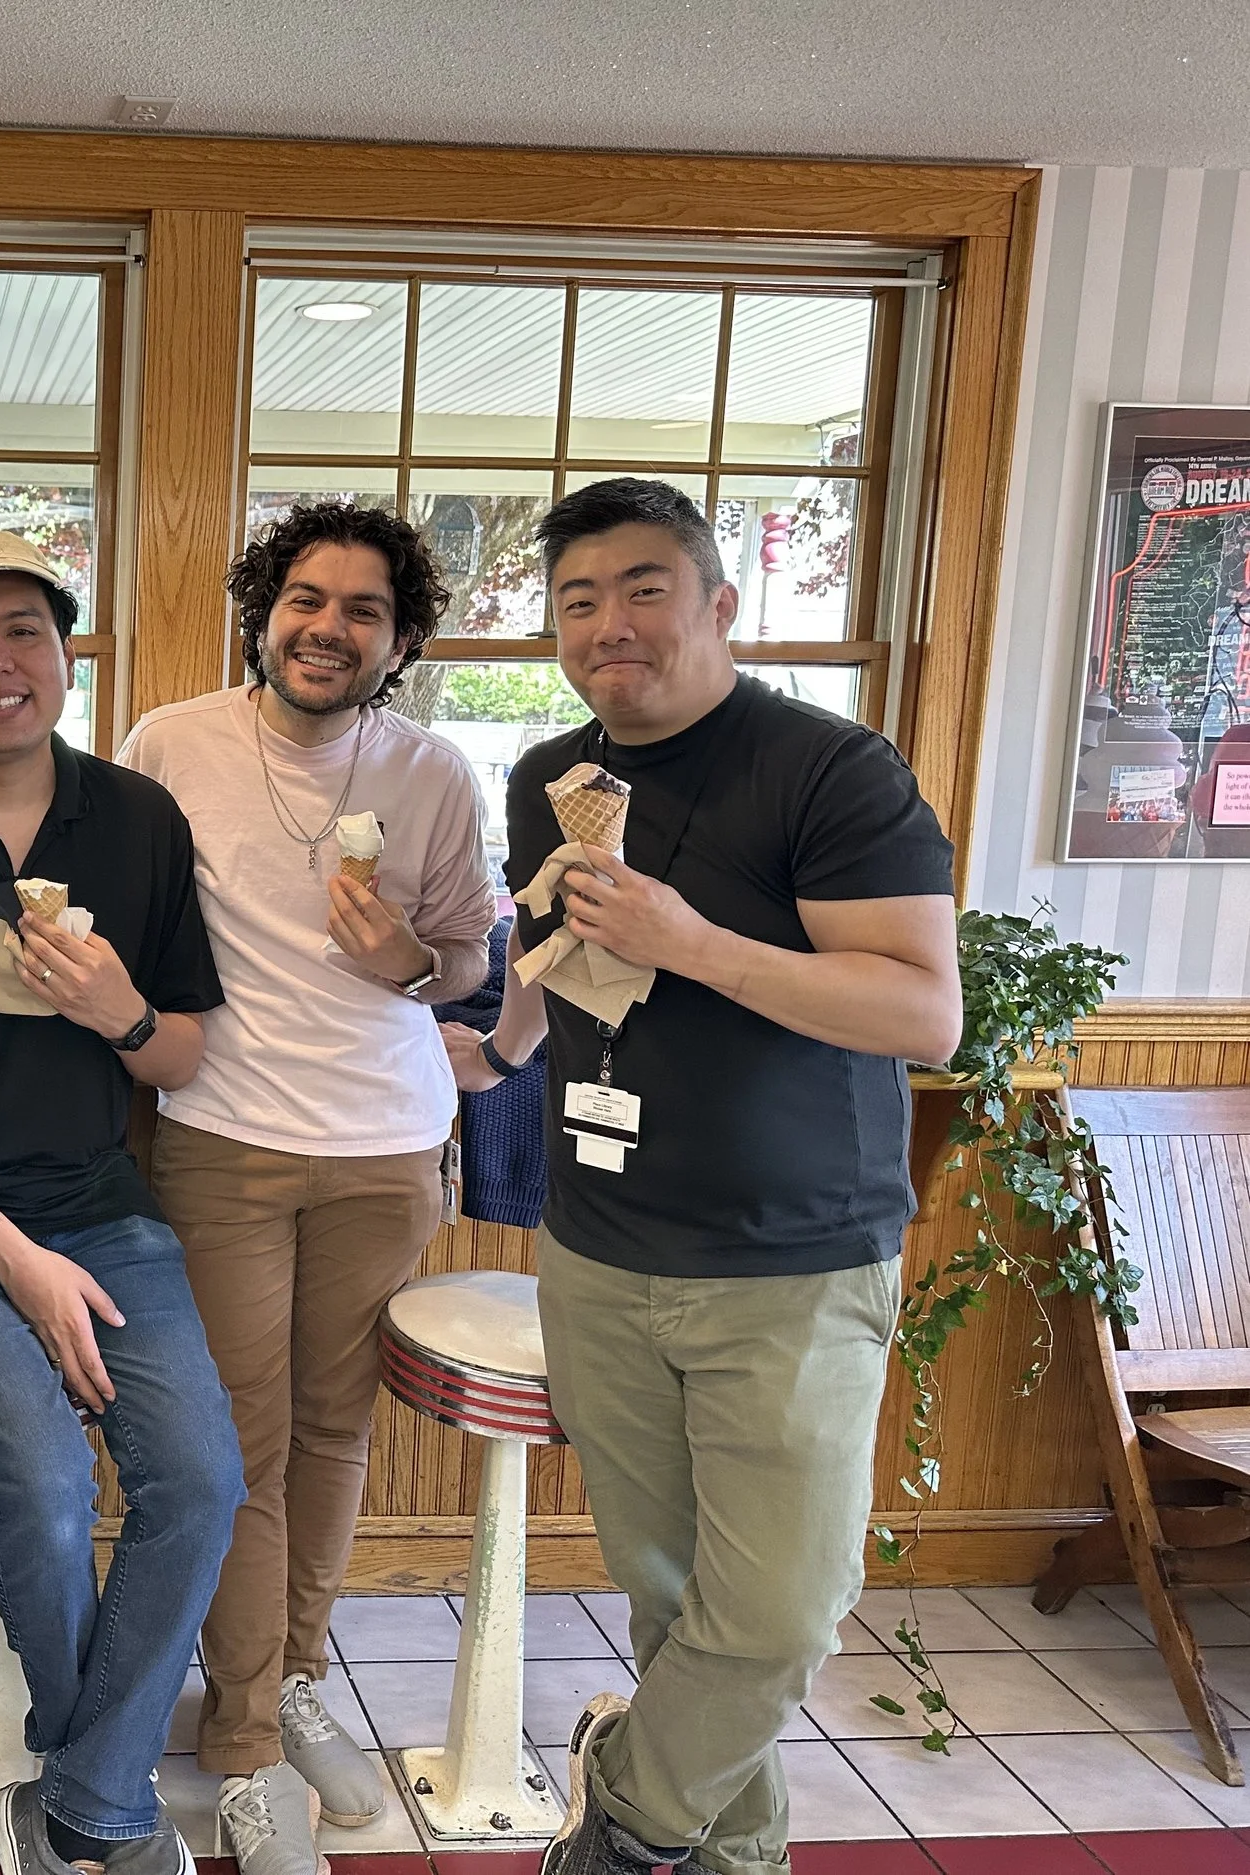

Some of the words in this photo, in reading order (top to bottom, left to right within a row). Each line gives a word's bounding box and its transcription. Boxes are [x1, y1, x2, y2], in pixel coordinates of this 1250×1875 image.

[1208, 633, 1250, 647] DREAM
[1225, 782, 1239, 791] light
[1240, 782, 1248, 790] of
